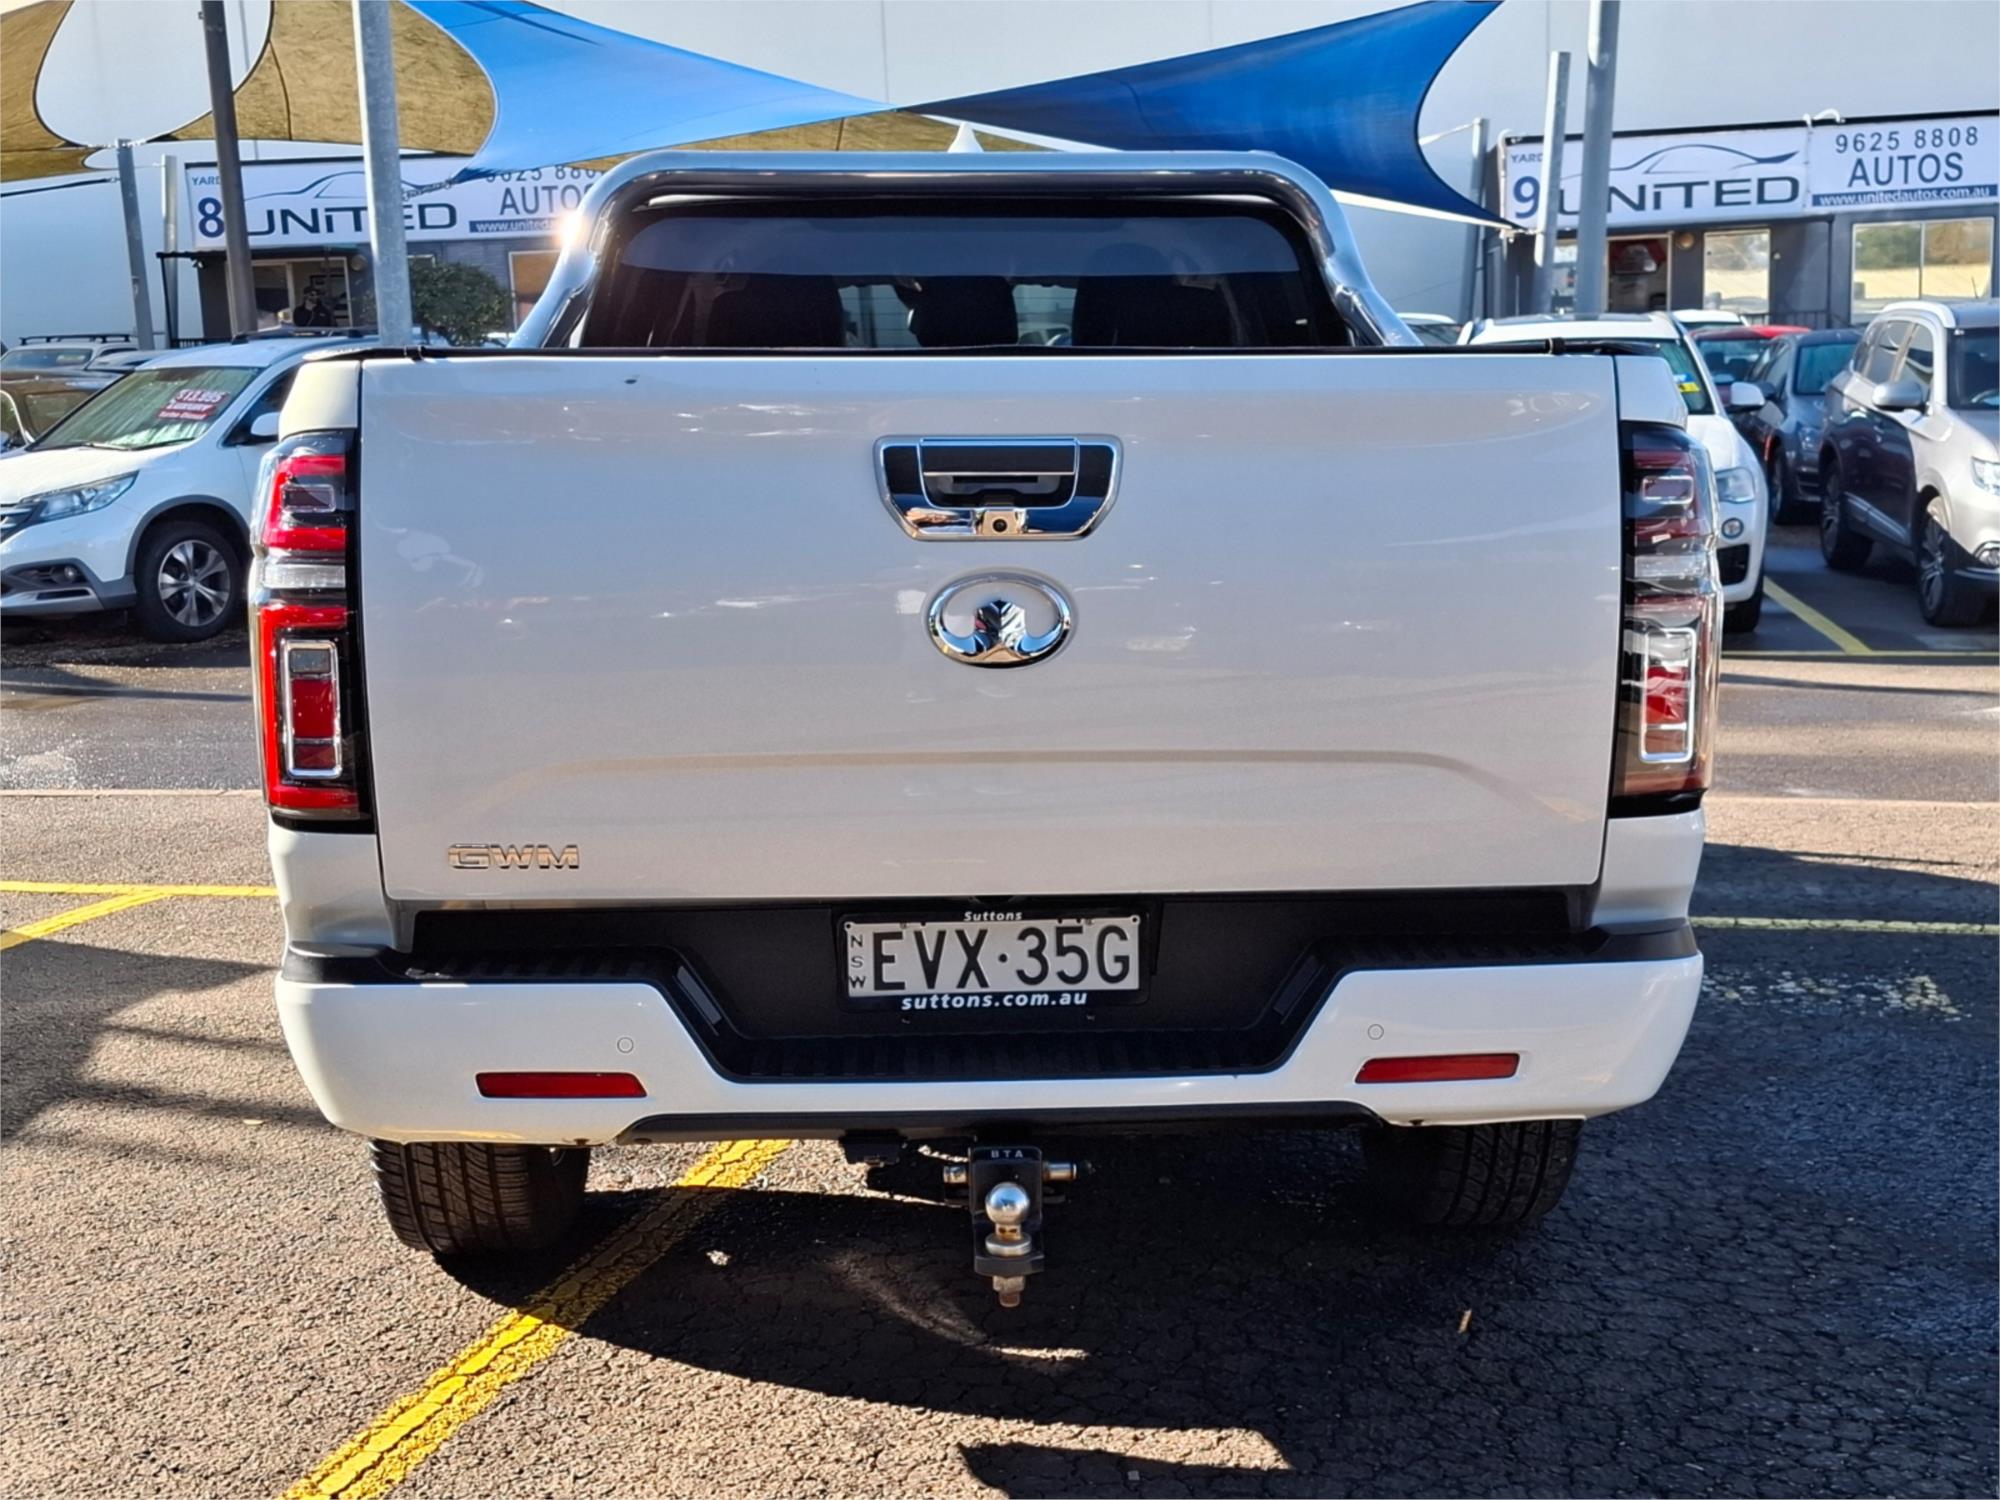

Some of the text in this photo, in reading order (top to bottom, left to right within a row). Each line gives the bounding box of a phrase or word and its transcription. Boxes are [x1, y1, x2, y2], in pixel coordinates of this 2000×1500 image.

[1835, 126, 1978, 154] 9625 8808
[1848, 151, 1963, 188] AUTOS
[1513, 175, 1540, 219] 9
[1819, 184, 1990, 207] www.unitedautos.com.au
[198, 197, 225, 238] 8
[448, 844, 579, 870] GWM
[964, 910, 1023, 922] Suttons
[849, 935, 866, 989] NSW
[901, 991, 1088, 1011] suttons.com.au
[990, 1149, 1024, 1159] BTA
